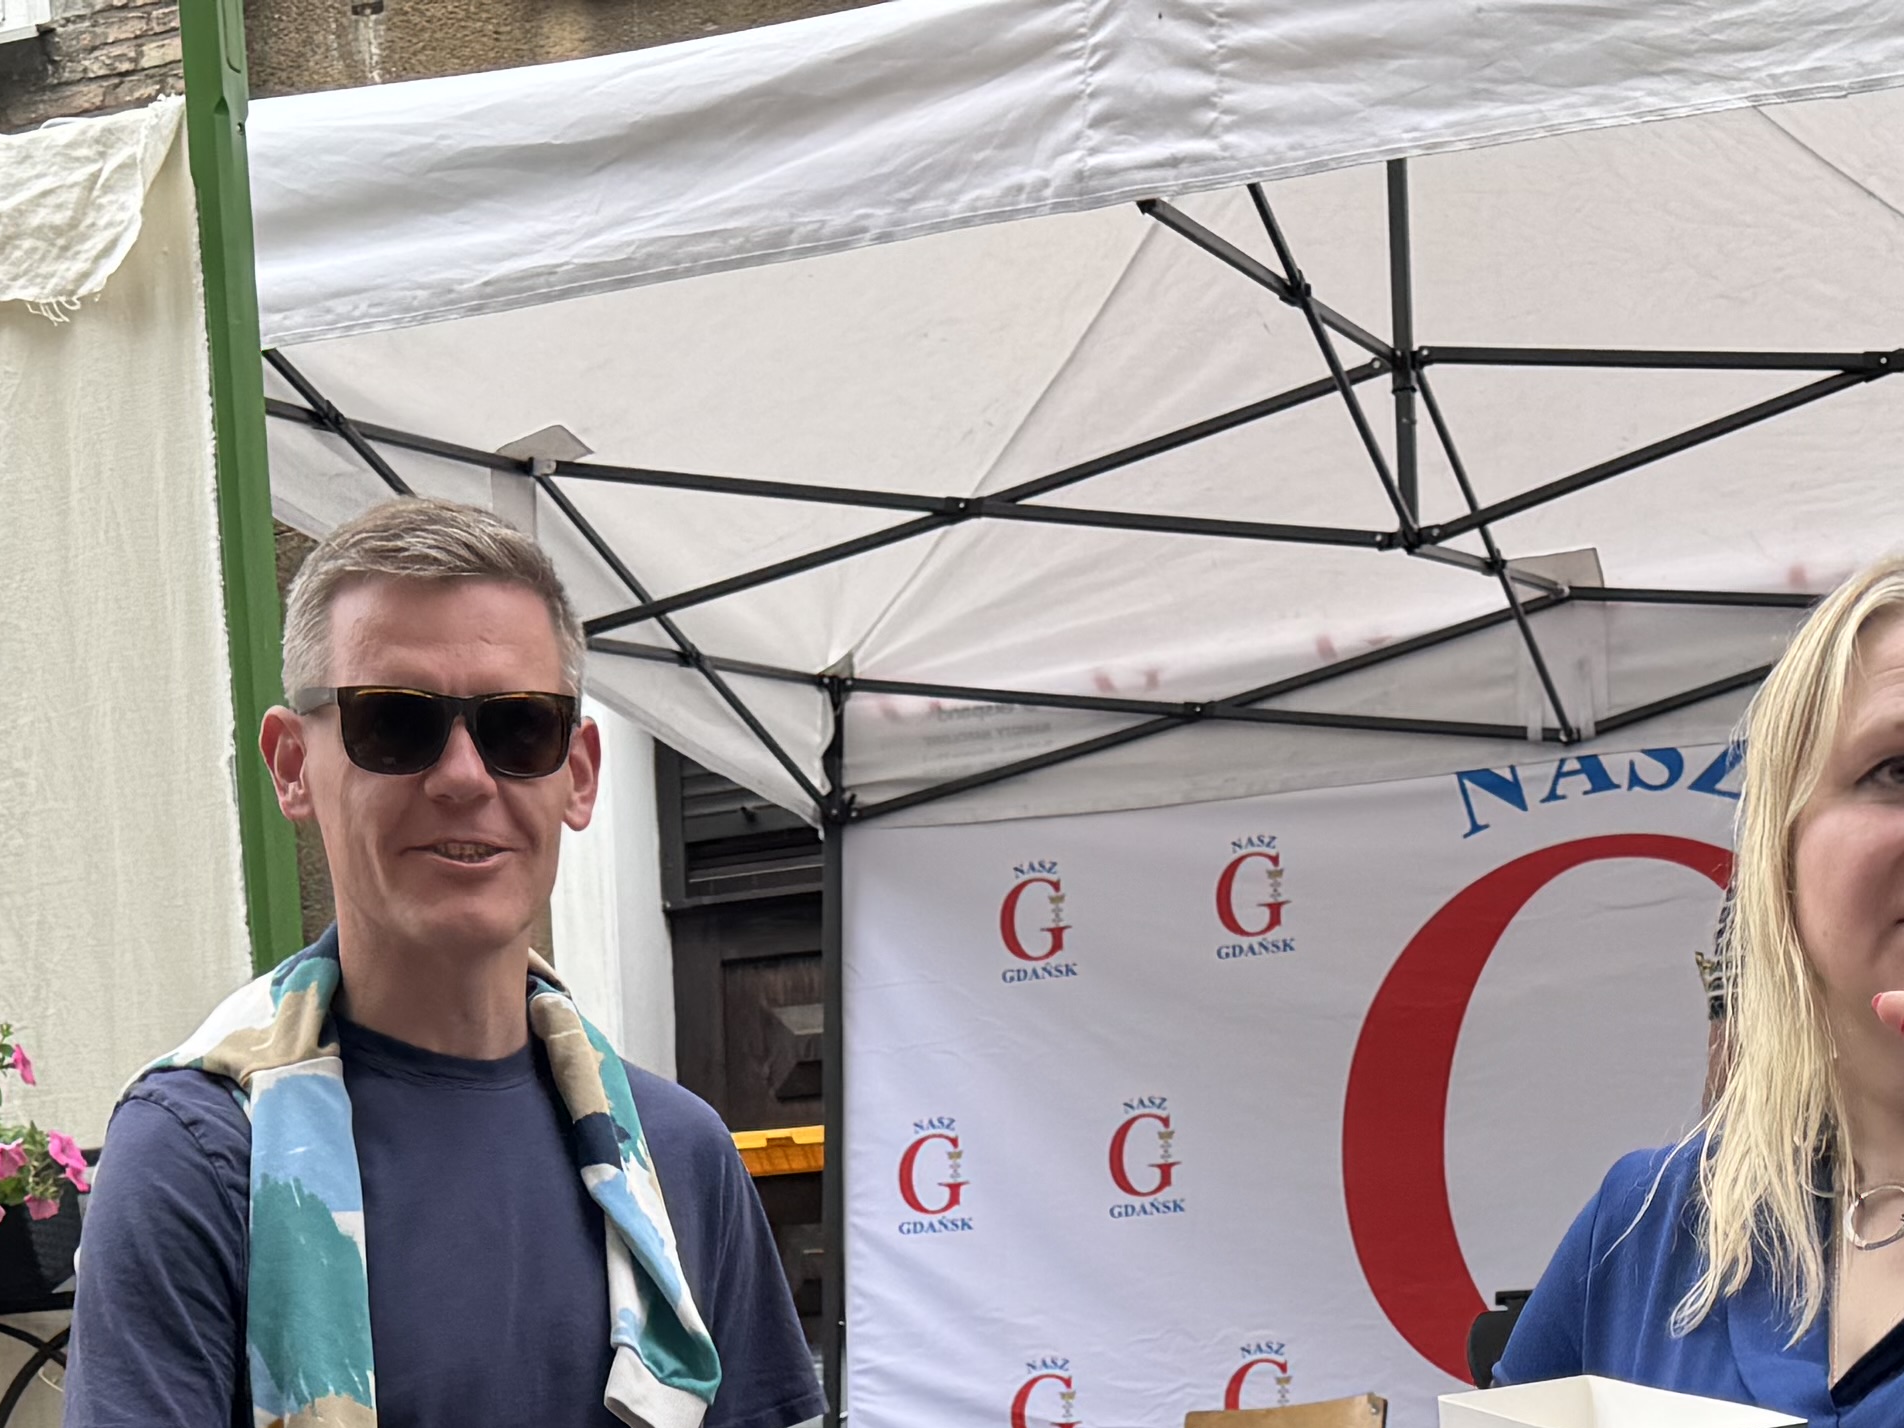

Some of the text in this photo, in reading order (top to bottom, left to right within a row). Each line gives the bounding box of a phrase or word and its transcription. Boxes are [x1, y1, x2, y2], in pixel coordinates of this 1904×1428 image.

[1231, 835, 1276, 853] NASZ
[1013, 860, 1058, 878] NASZ
[1216, 852, 1291, 937] G
[1000, 877, 1072, 962] G
[1217, 938, 1295, 960] GDAŃSK
[1002, 963, 1078, 984] GDAŃSK
[1123, 1096, 1168, 1115] NASZ
[912, 1116, 957, 1134] NASZ
[1109, 1112, 1181, 1198] G
[897, 1133, 969, 1216] G
[1109, 1198, 1185, 1219] GDAŃSK
[898, 1215, 974, 1236] GDAŃSK
[1240, 1341, 1286, 1359] NASZ
[1025, 1356, 1070, 1374] NASZ
